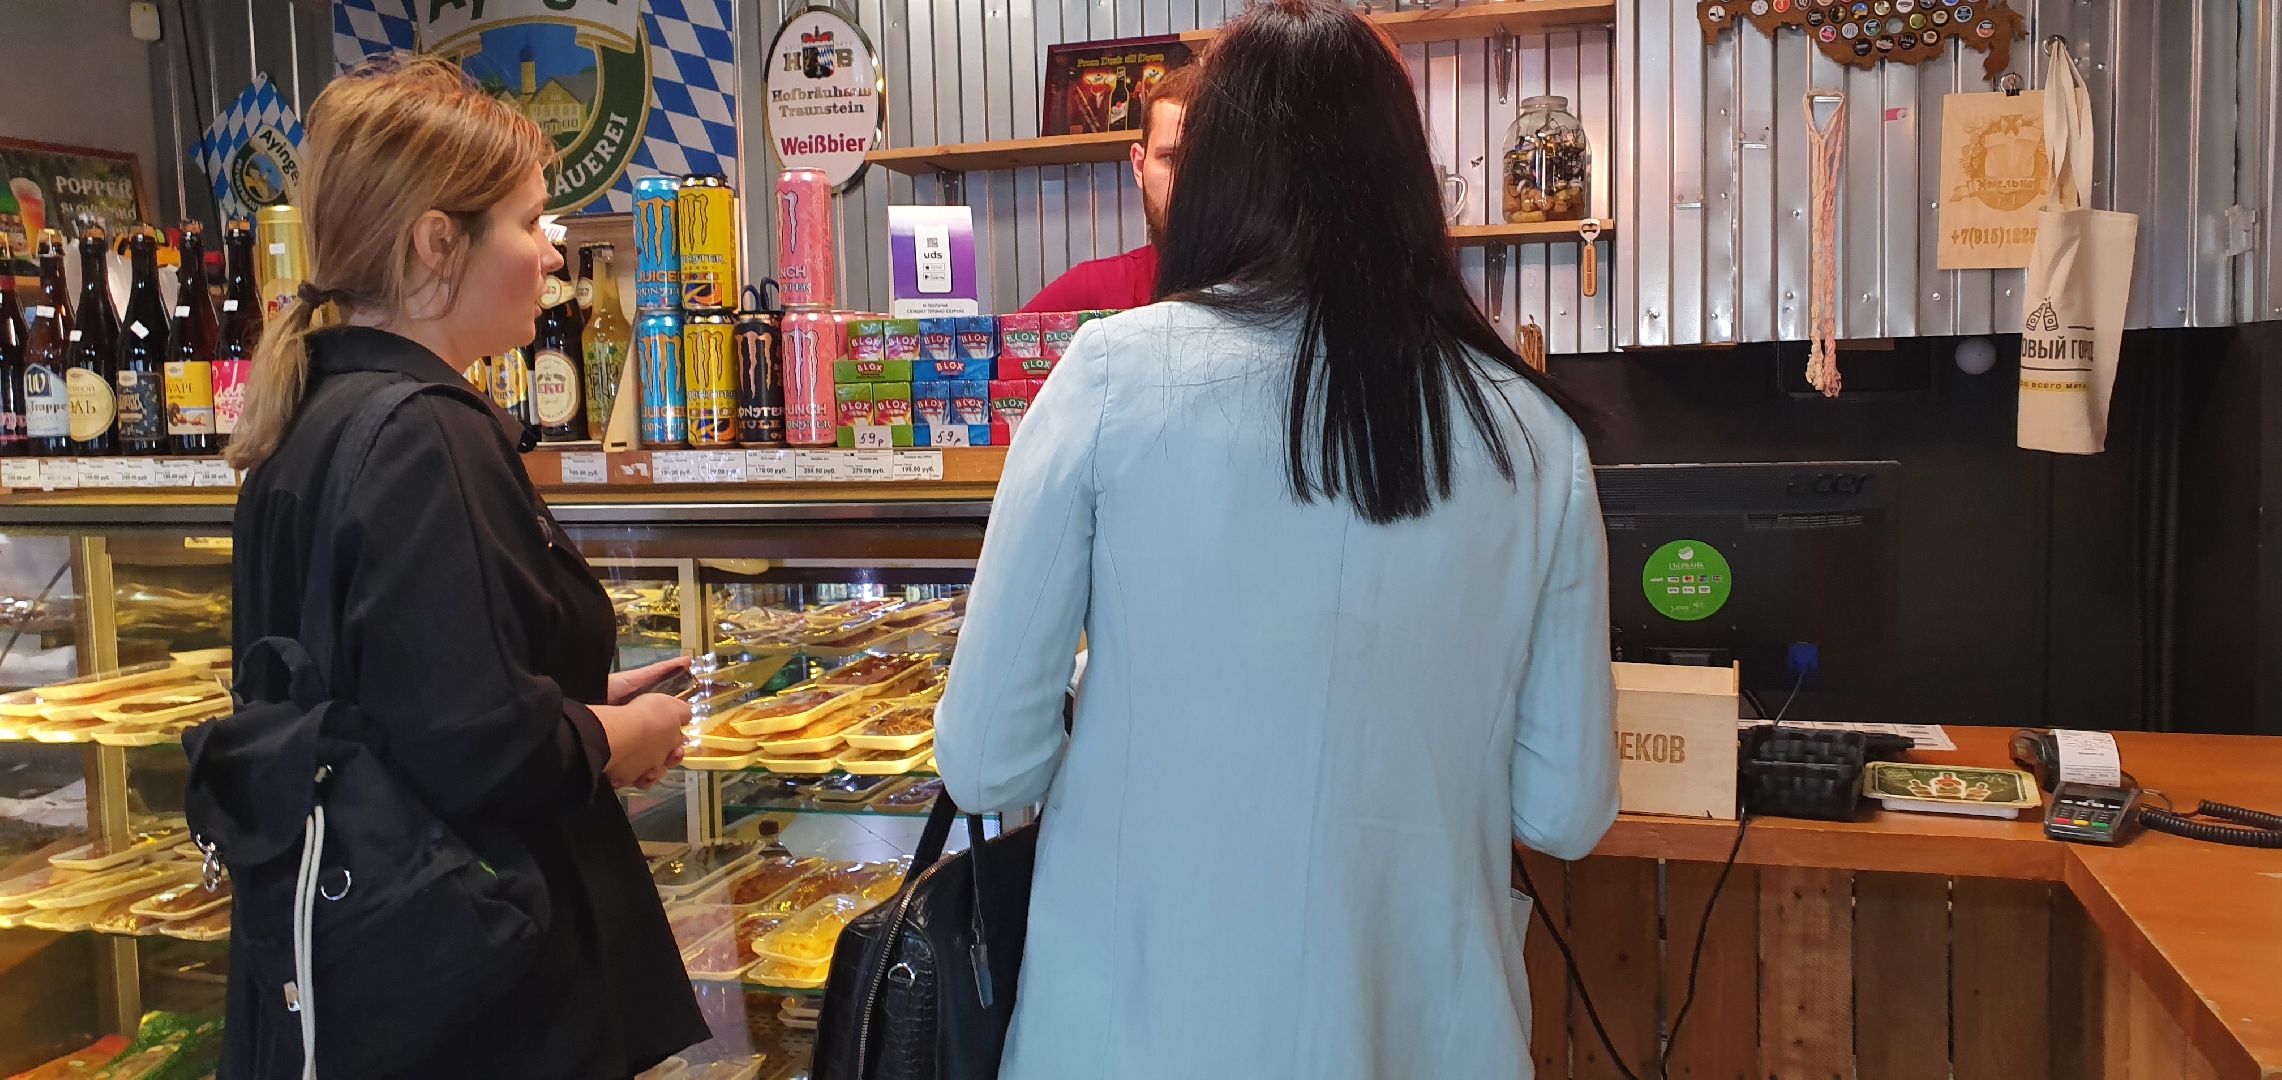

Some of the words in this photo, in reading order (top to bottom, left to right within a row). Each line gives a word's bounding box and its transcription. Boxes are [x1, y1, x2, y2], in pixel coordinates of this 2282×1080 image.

[779, 101, 865, 118] Traunstein
[780, 133, 866, 156] Weißbier
[543, 111, 628, 198] AUEREI
[923, 250, 943, 259] uds
[924, 333, 952, 345] BLOX
[961, 333, 989, 344] BLOX
[1006, 332, 1038, 343] BLOX
[857, 362, 883, 372] BLOX
[936, 361, 965, 372] BLOX
[1022, 360, 1053, 370] BLOX
[841, 401, 869, 412] BLOX
[878, 400, 908, 410] BLOX
[918, 400, 946, 409] BLOX
[995, 399, 1027, 409] BLOX
